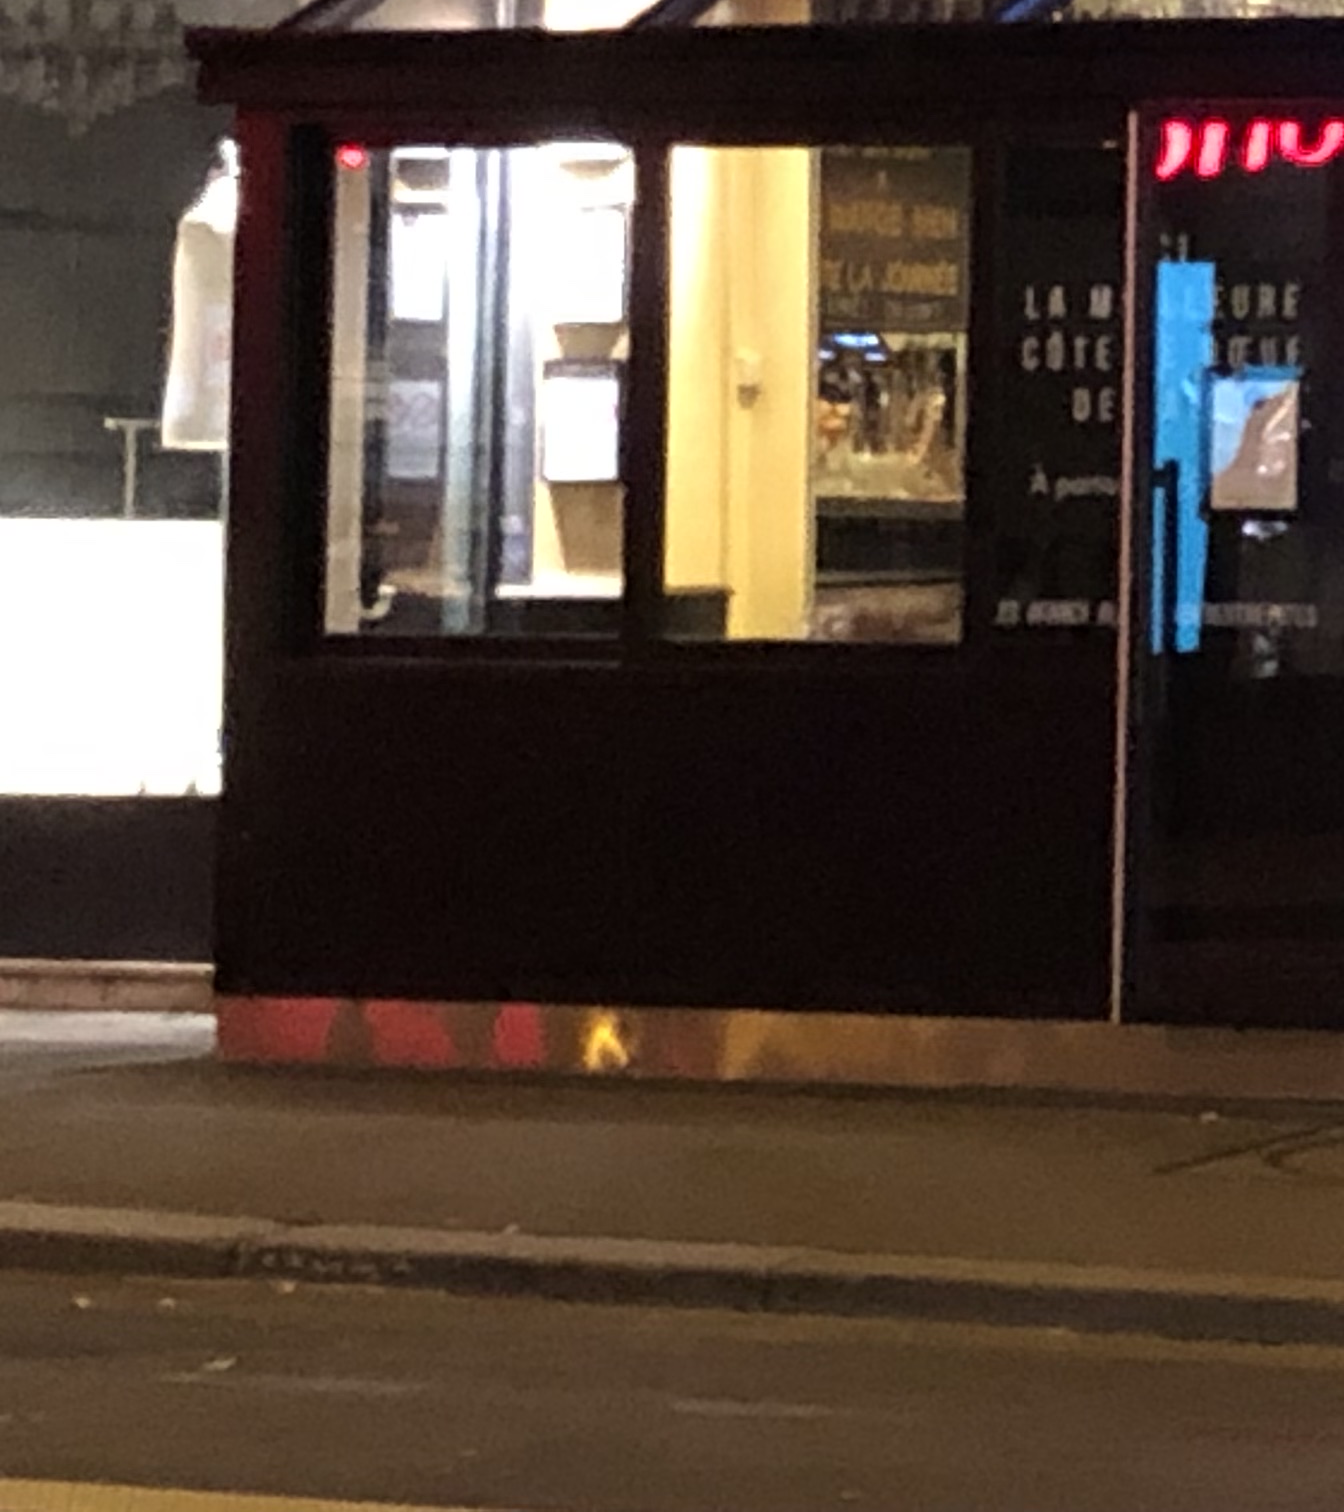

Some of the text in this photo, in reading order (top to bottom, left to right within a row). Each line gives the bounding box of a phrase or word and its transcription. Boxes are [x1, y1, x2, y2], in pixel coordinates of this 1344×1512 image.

[1023, 284, 1067, 321] LA
[1020, 330, 1114, 372] CÔTE
[1070, 388, 1116, 423] DE
